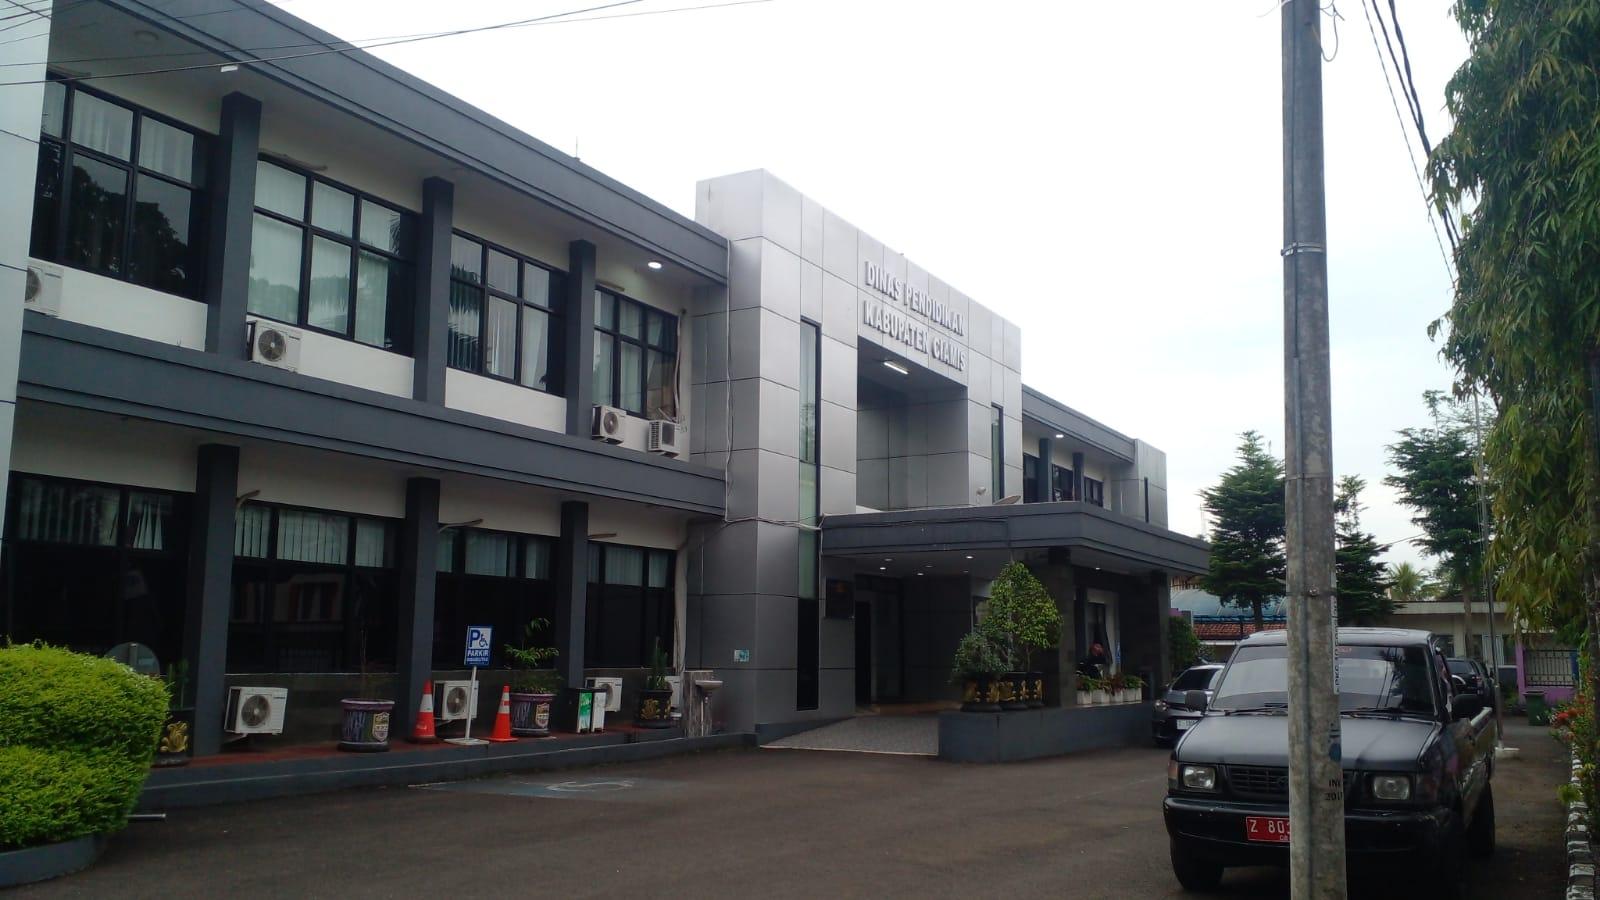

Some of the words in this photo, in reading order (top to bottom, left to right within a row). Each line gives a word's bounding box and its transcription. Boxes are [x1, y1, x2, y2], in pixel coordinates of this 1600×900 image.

[864, 261, 901, 301] DINAS
[903, 282, 964, 336] PENDIDIKAN
[863, 300, 929, 354] KABUPATEN
[931, 337, 967, 371] CIAMIS
[469, 629, 481, 648] P
[467, 649, 489, 657] PARKIR
[1250, 819, 1258, 833] Z
